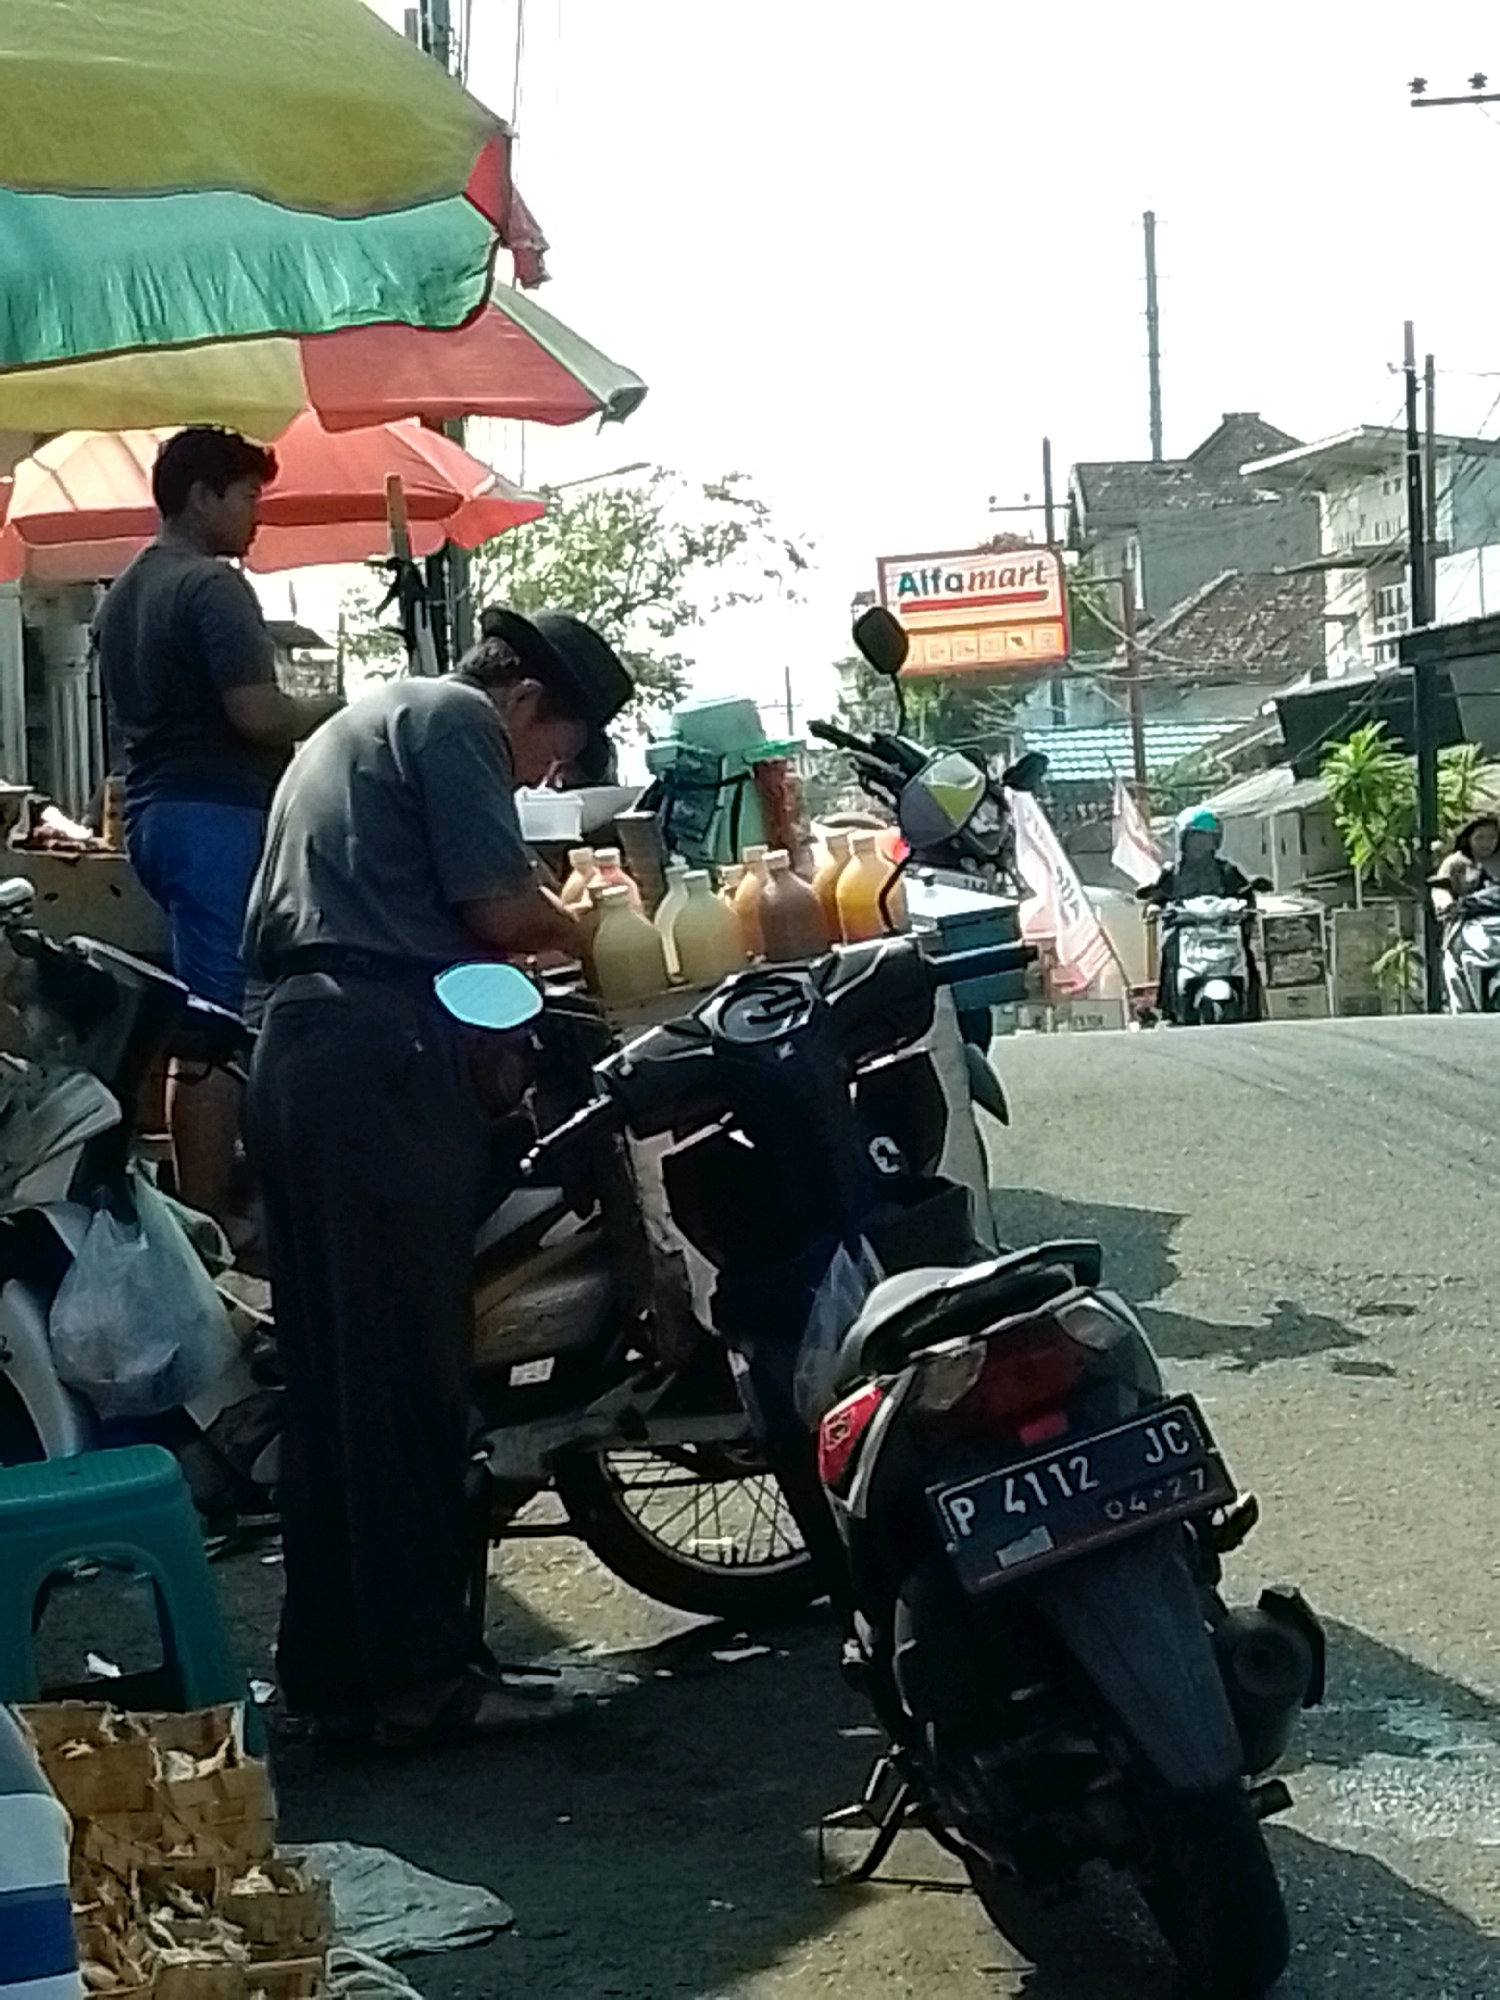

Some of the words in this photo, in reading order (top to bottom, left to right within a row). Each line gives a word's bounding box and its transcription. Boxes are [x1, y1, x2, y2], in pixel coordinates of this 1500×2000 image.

[897, 561, 1048, 597] Alfamart
[950, 1496, 976, 1536] P
[1004, 1456, 1099, 1514] 4112
[1146, 1421, 1189, 1463] JC
